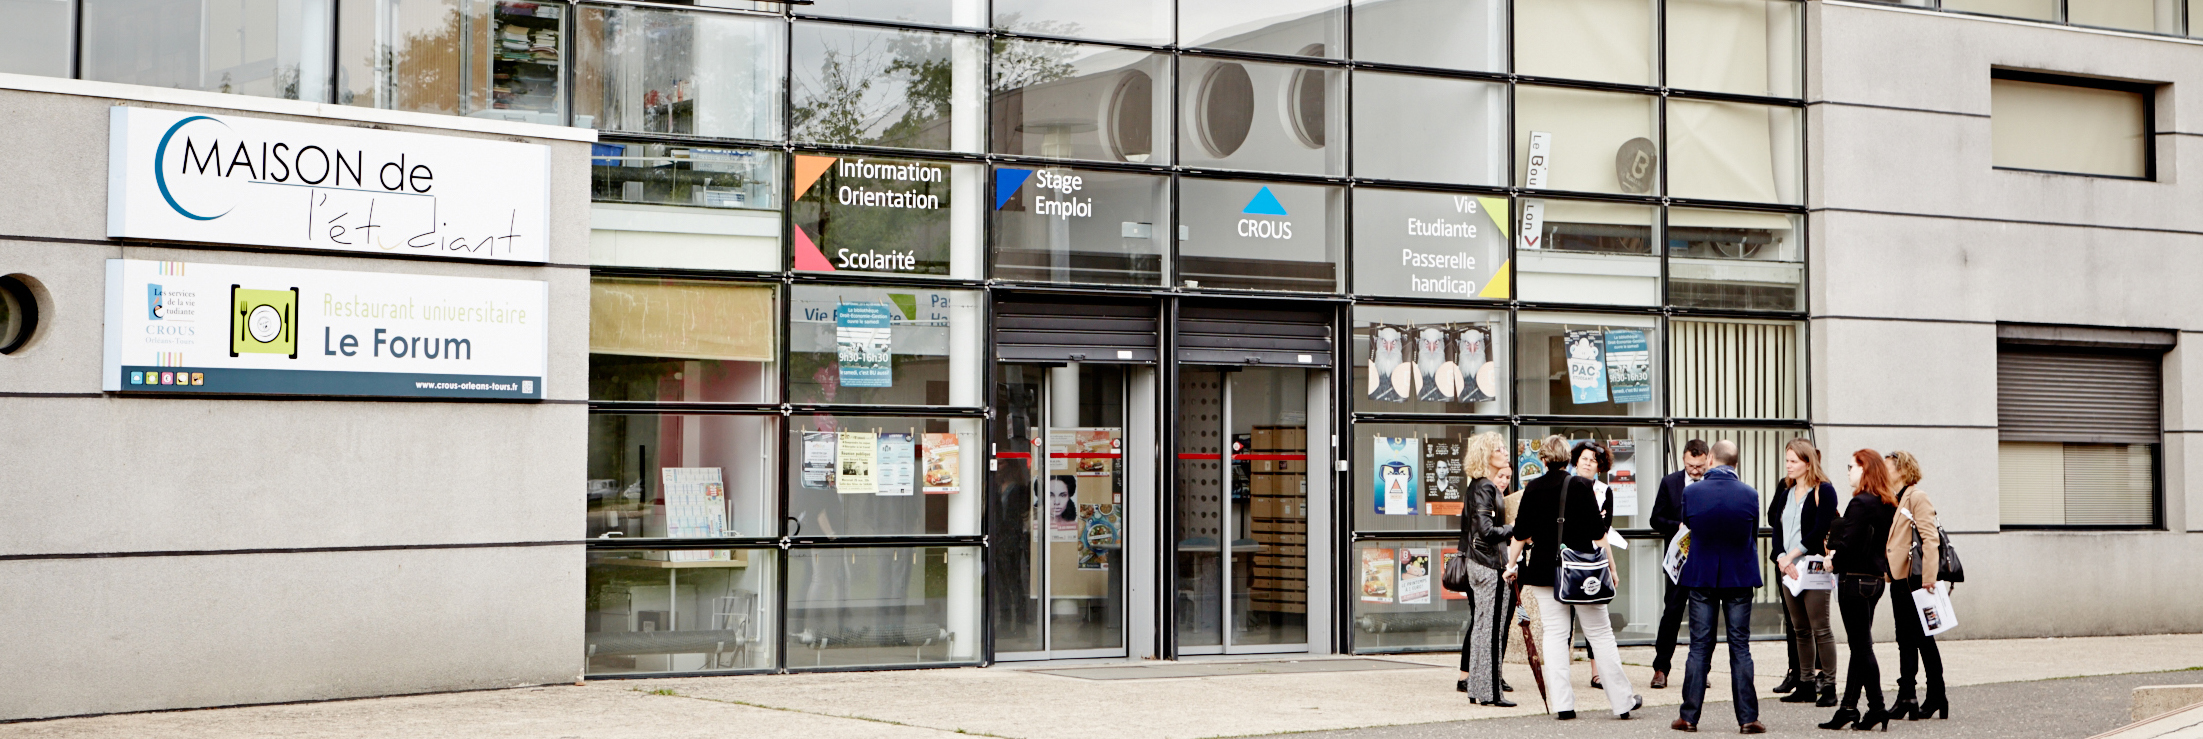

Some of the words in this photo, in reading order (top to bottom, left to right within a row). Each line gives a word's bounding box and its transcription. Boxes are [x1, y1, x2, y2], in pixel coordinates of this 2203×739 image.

[182, 135, 362, 187] MAISON
[380, 153, 434, 193] de
[839, 158, 942, 183] Information
[1036, 169, 1082, 194] Stage
[838, 185, 939, 210] Orientation
[1035, 196, 1092, 220] Emploi
[1454, 196, 1477, 214] Vie
[1238, 219, 1292, 240] CROUS
[1408, 218, 1477, 238] Etudiante
[838, 248, 915, 270] Scolarité
[1402, 248, 1476, 270] Passerelle
[154, 288, 167, 297] Les
[1412, 274, 1476, 297] handicap
[167, 298, 176, 306] de
[323, 293, 415, 320] Restaurant
[423, 299, 526, 324] universitaire
[145, 325, 195, 336] CROUS
[324, 326, 359, 357] Le
[374, 328, 471, 360] Forum
[839, 352, 888, 363] 9h30-16h30
[1572, 364, 1596, 376] PAC
[415, 381, 518, 392] www.crous-orleans-tours.fr
